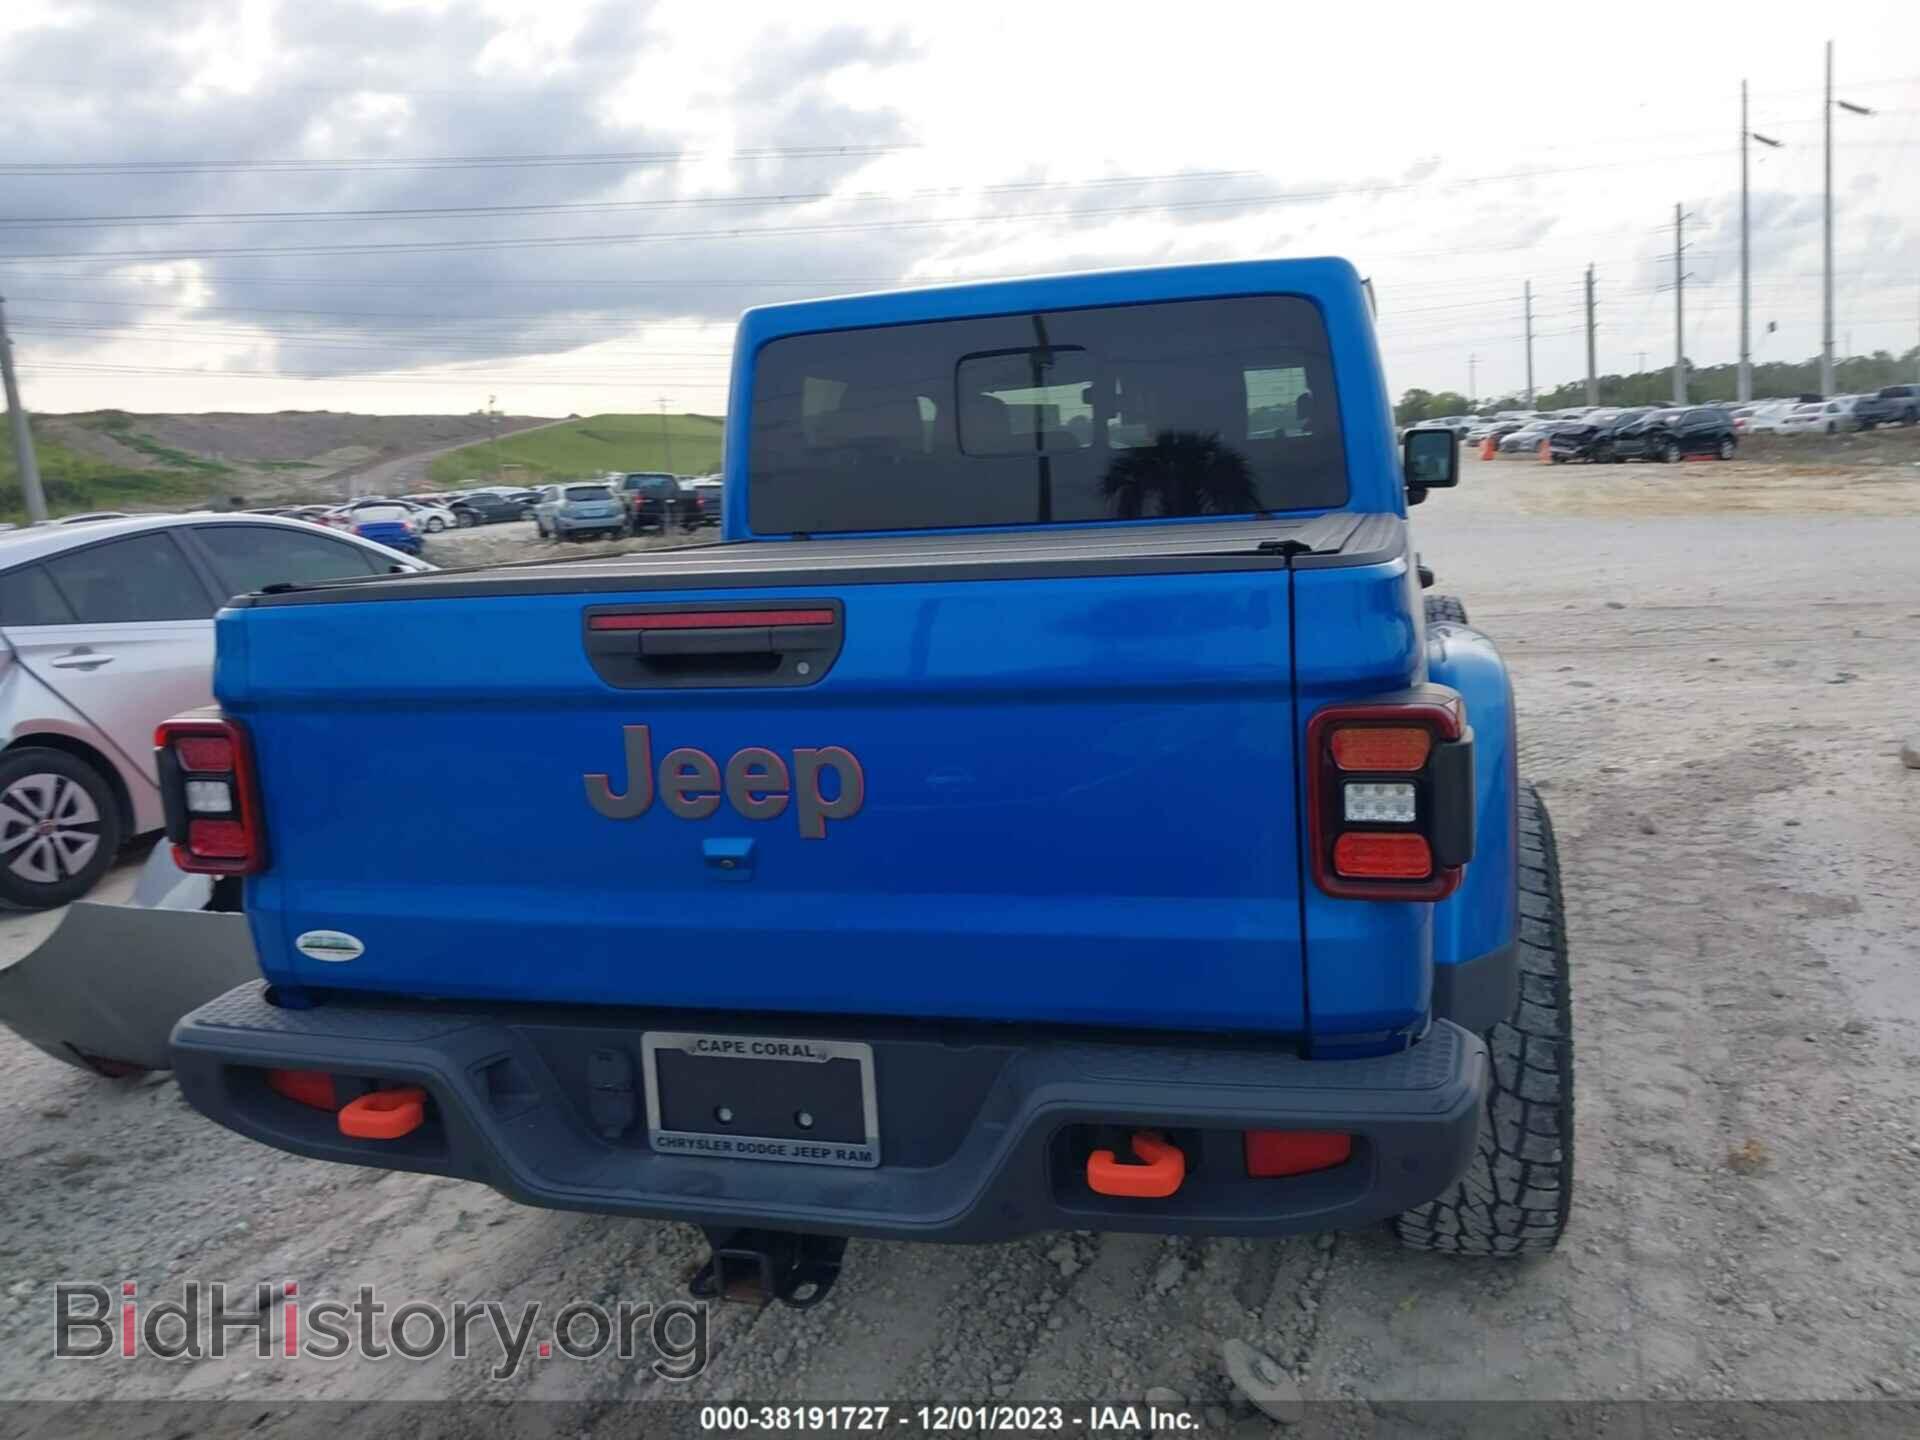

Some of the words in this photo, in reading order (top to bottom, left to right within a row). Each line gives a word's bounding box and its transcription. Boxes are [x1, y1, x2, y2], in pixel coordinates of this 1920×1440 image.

[583, 724, 864, 839] Jeep
[696, 1039, 746, 1054] CAPE
[751, 1042, 816, 1058] CORAL
[656, 1136, 733, 1152] CHRYSLER
[736, 1141, 787, 1157] DODGE
[791, 1147, 831, 1160] JEEP
[836, 1149, 874, 1163] RAM
